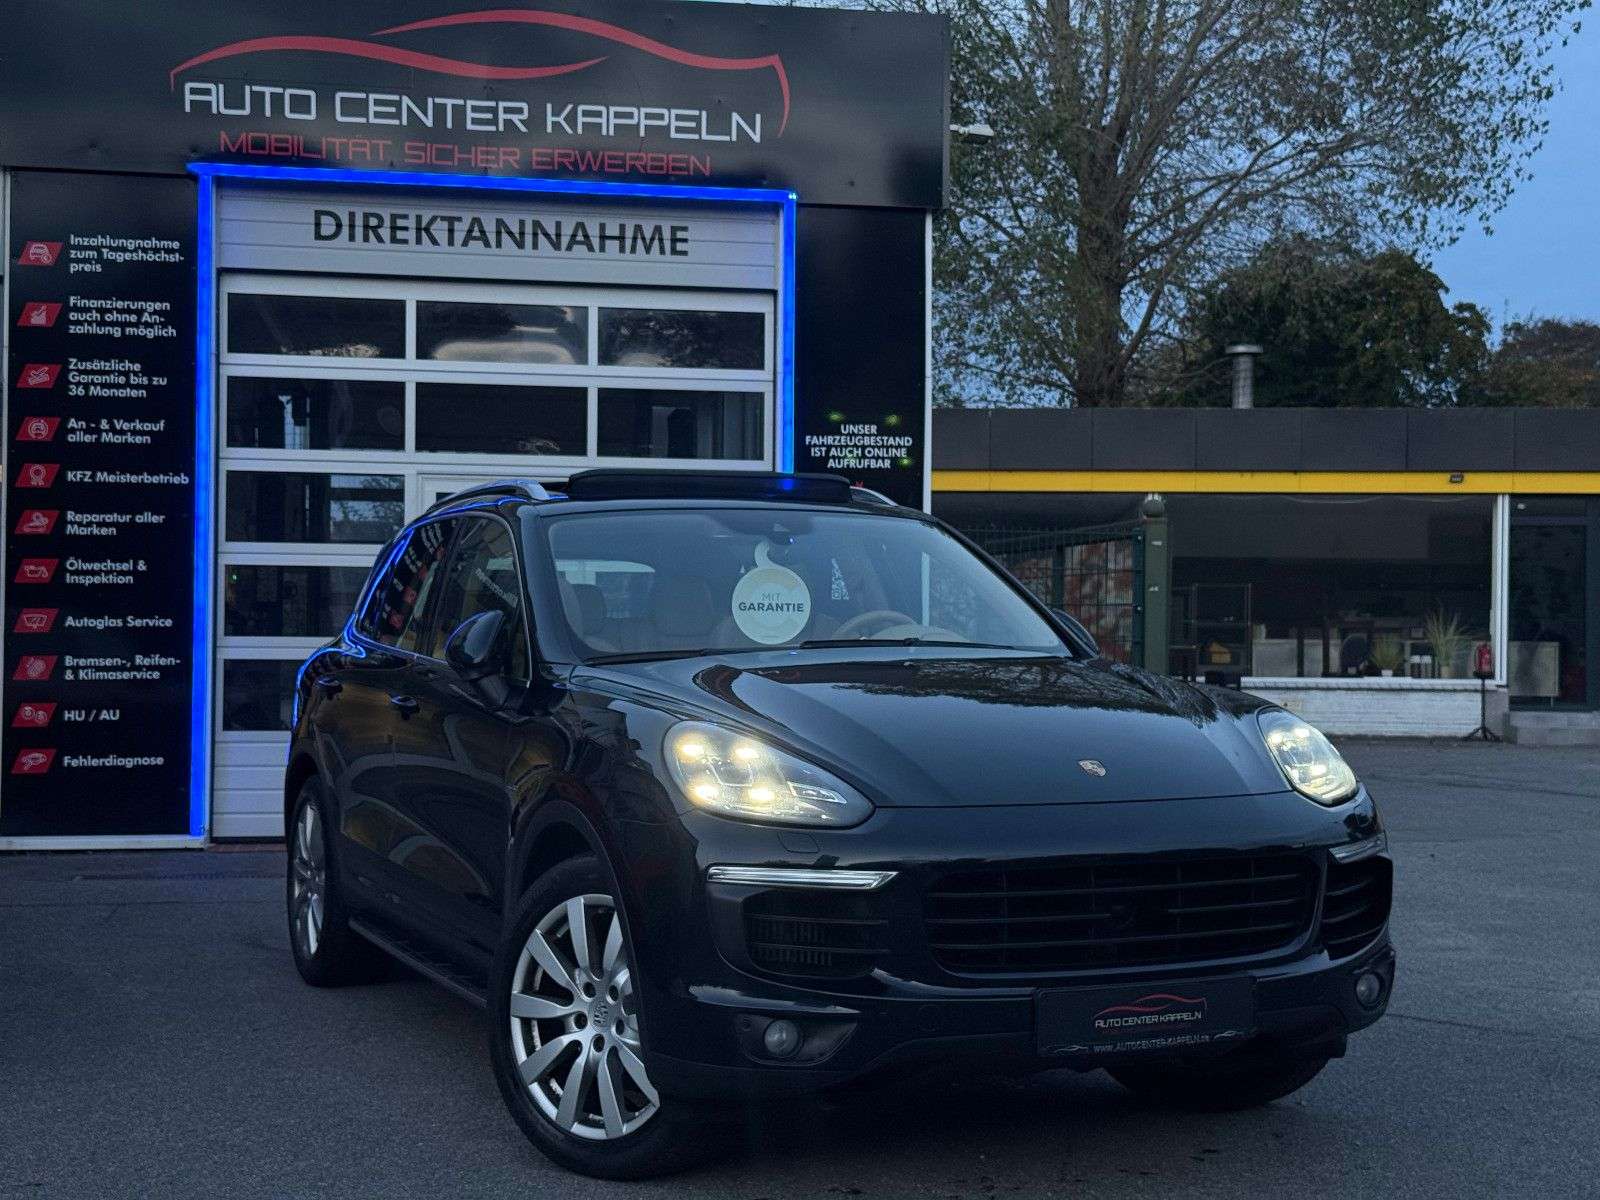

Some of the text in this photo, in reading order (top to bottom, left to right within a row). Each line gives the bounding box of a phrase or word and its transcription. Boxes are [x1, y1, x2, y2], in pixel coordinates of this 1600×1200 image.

[184, 82, 761, 144] AUTO CENTER KAPPELN
[404, 141, 520, 170] SICHER
[532, 147, 711, 176] ERWERBEN
[314, 210, 689, 256] DIREKTANNAHME
[70, 234, 180, 250] Inzahlungnahme
[70, 249, 184, 262] zum Tageshöchst-
[70, 260, 102, 274] preis
[69, 296, 170, 312] Finanzierungen
[69, 310, 165, 323] auch ohne An-
[68, 324, 176, 338] zahlung möglich
[68, 358, 142, 372] Zusätzliche
[68, 372, 168, 386] Garantie bis zu
[68, 386, 146, 398] 36 Monaten
[100, 419, 110, 430] &
[113, 420, 165, 432] Verkauf
[840, 424, 877, 434] UNSER
[68, 432, 151, 444] aller Marken
[806, 436, 912, 446] FAHRZEUGBESTAND
[810, 448, 908, 458] IST AUCH ONLINE
[827, 459, 890, 468] AUFRUFBAR
[67, 471, 190, 484] KFZ Meisterbetrieb
[67, 511, 166, 524] Reparatur aller
[66, 524, 117, 536] Marken
[66, 557, 148, 572] Ölwechsel &
[66, 572, 134, 586] Inspektion
[761, 592, 780, 601] MIT
[738, 602, 804, 612] GARANTIE
[65, 616, 173, 630] Autoglas Service
[135, 654, 181, 666] Reifen-
[64, 668, 160, 680] & Klimaservice
[64, 710, 120, 722] HU / AU
[64, 755, 164, 768] Fehlerdiagnose
[1095, 1012, 1202, 1028] AUTO CENTER KAPPELN
